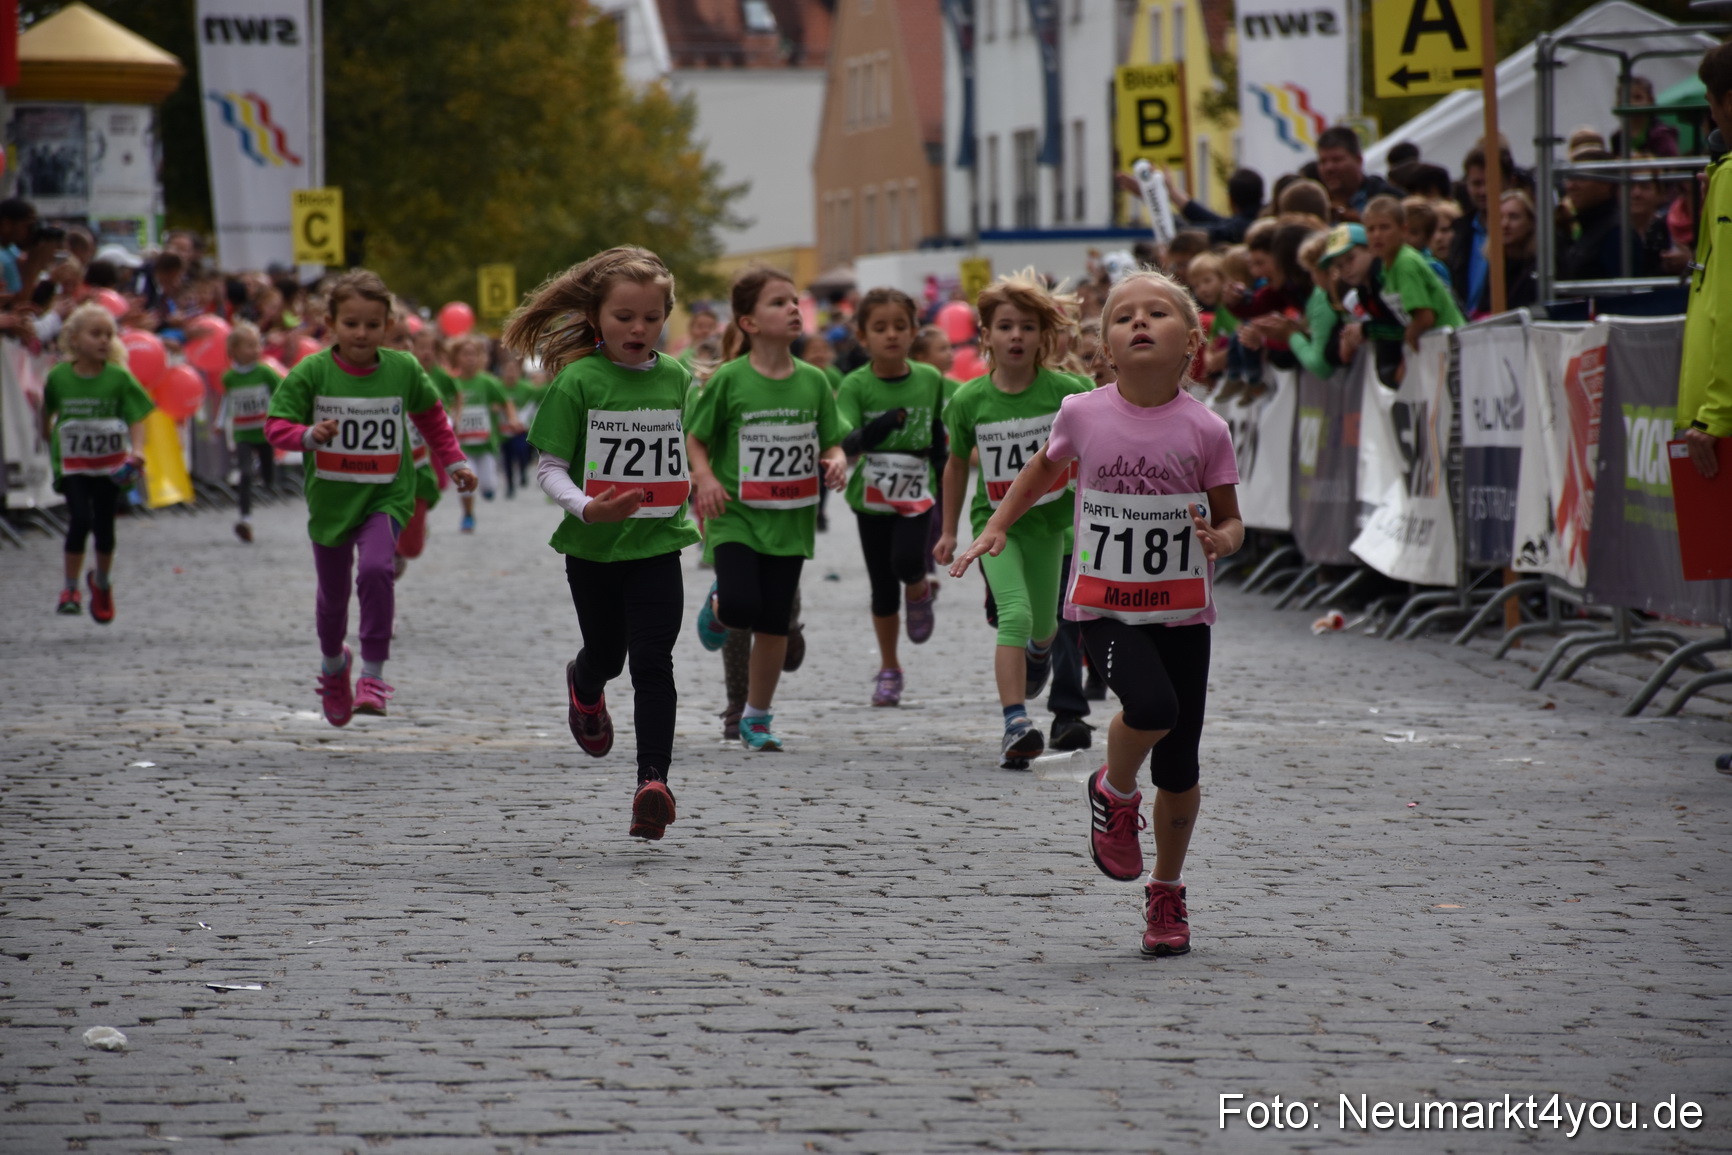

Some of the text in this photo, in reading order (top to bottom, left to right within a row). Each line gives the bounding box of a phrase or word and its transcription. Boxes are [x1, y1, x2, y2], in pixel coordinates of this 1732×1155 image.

[1401, 0, 1469, 55] A
[1138, 98, 1171, 147] B
[304, 211, 329, 248] C
[348, 407, 389, 415] Neumarkt
[591, 420, 675, 432] PARTL Neumarkt
[978, 424, 1051, 442] PARTL Neumarkt
[66, 433, 122, 454] 7420
[742, 434, 770, 442] PARTL
[341, 459, 378, 471] Anouk
[600, 437, 681, 476] 7215
[749, 444, 814, 477] 7223
[986, 437, 1049, 476] 741
[1098, 456, 1169, 480] adidas
[771, 486, 799, 499] Katja
[873, 471, 923, 499] 7175
[1083, 501, 1187, 520] PARTL Neumarkt
[1090, 523, 1191, 575] 7181
[1104, 586, 1170, 607] Madlen
